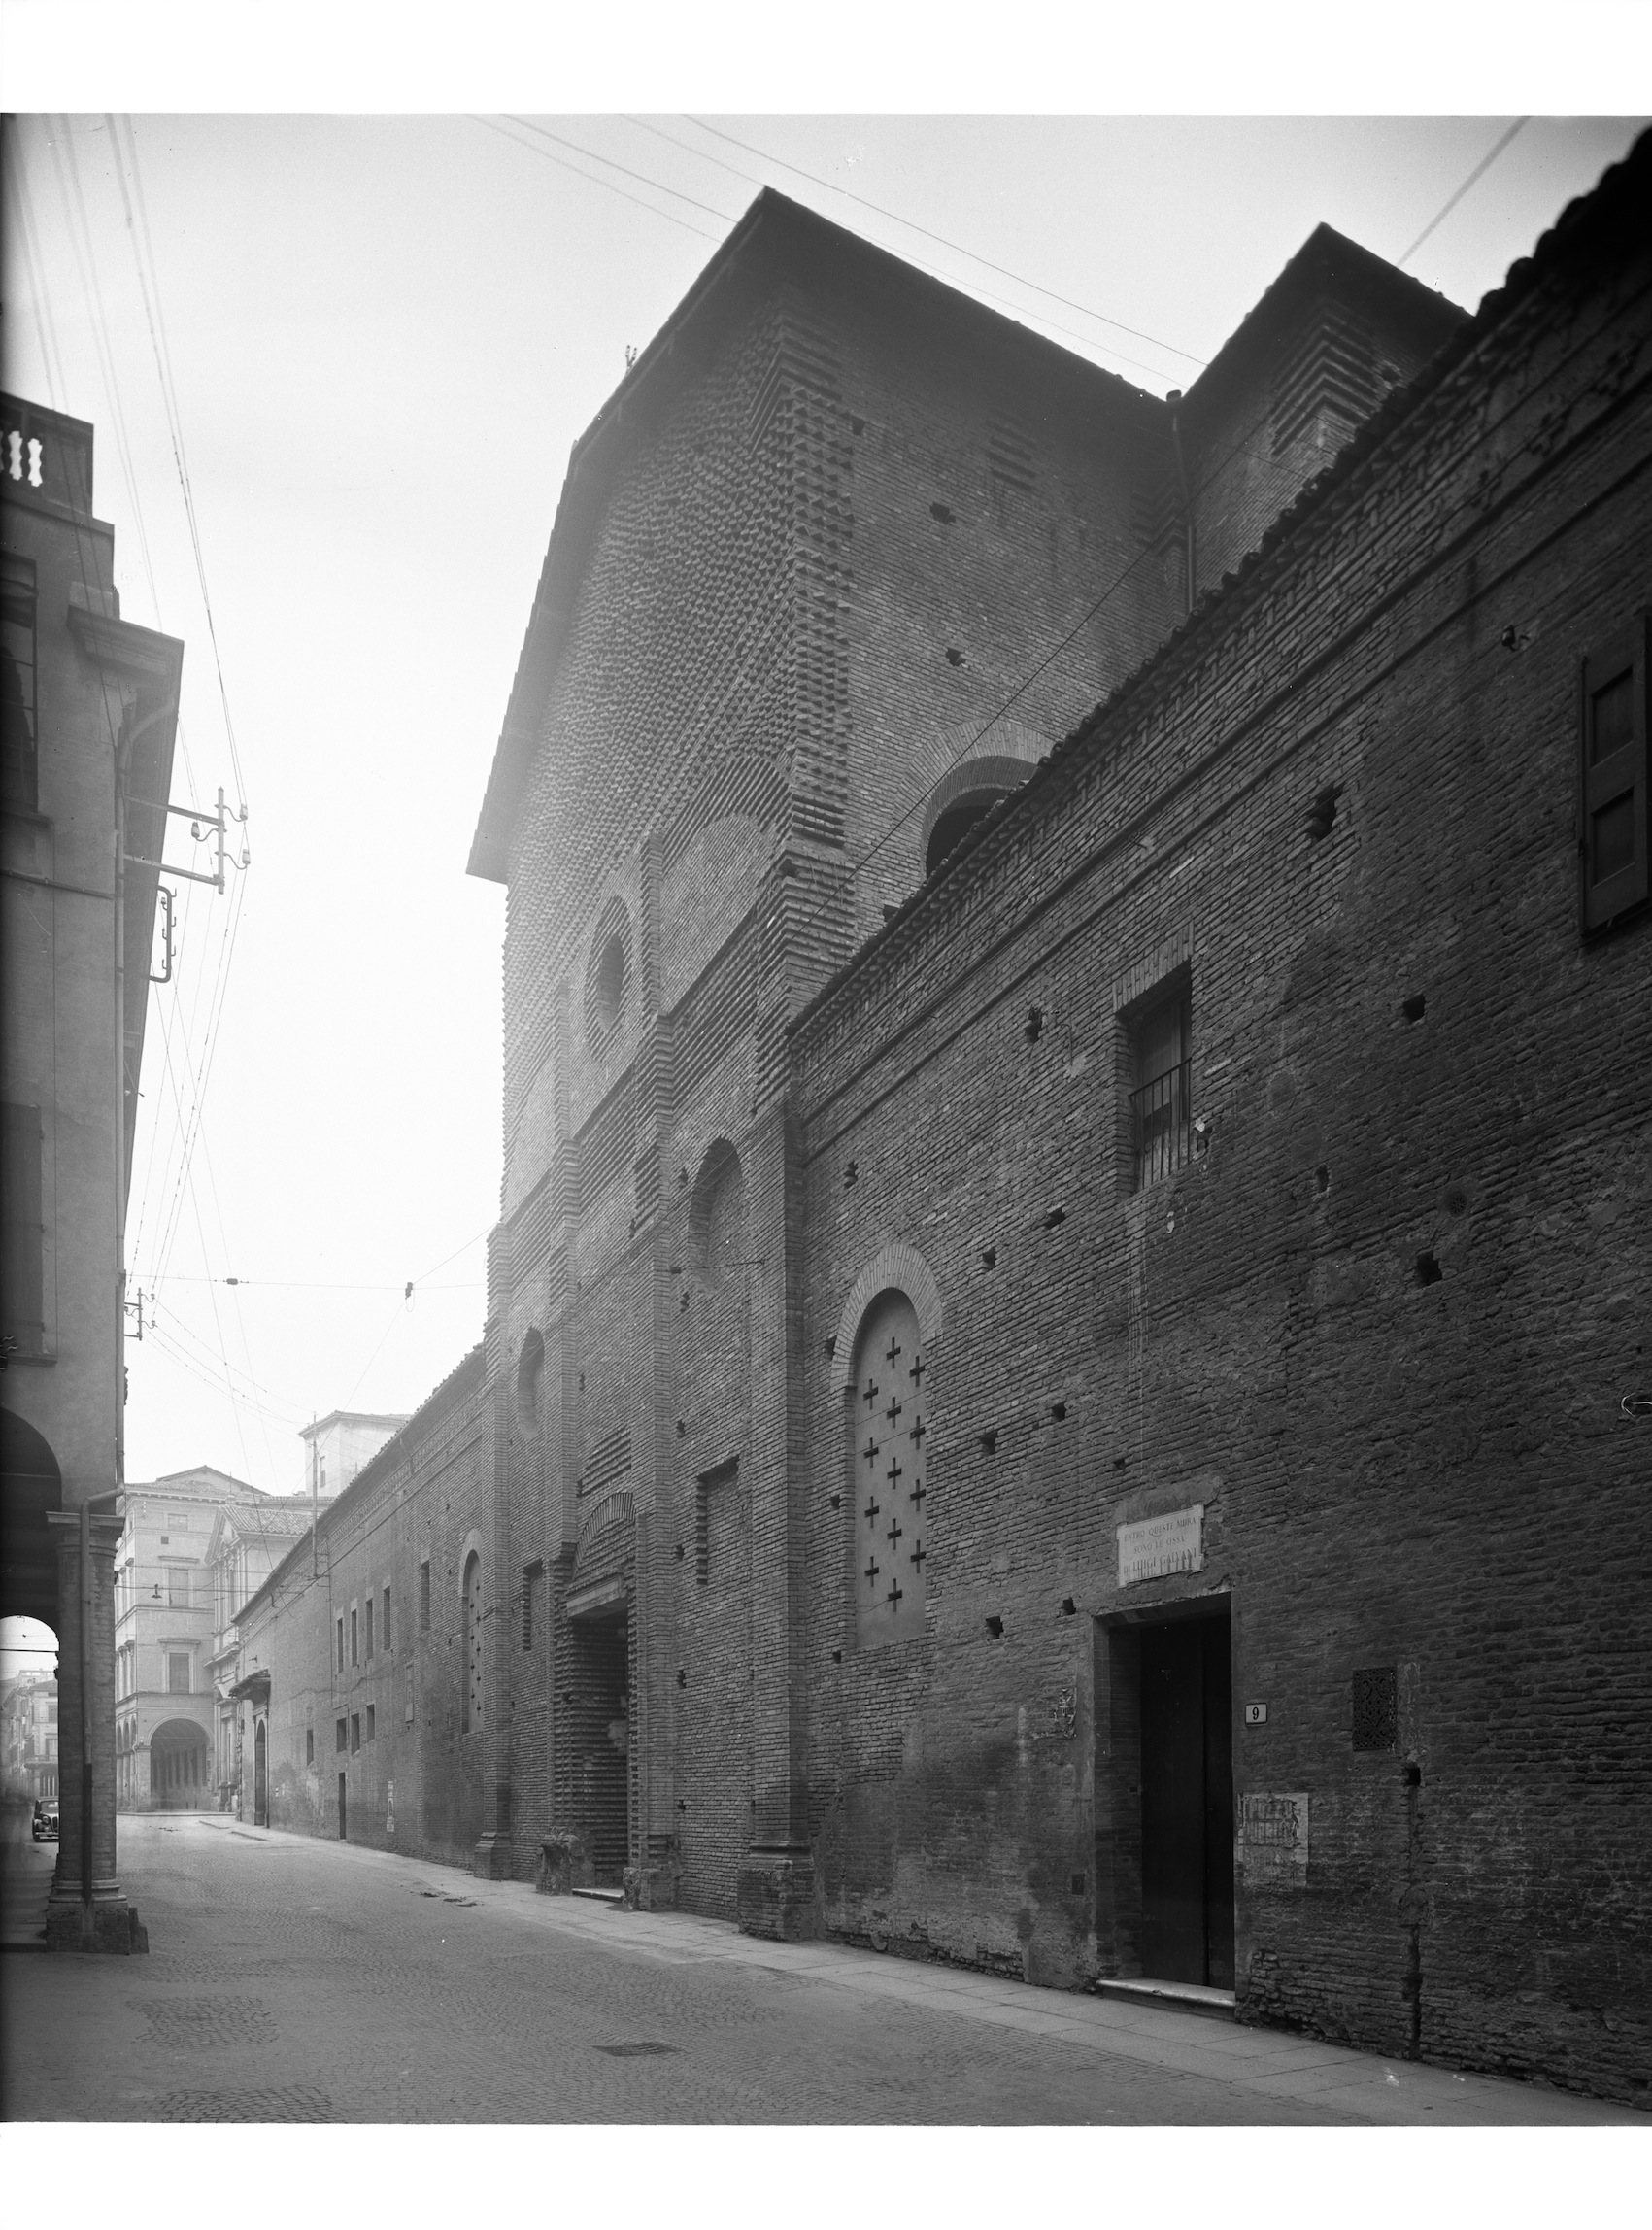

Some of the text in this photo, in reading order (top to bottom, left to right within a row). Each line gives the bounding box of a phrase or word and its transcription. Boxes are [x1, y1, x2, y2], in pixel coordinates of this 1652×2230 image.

[1124, 1517, 1197, 1542] ENTRO QUESTE MURA
[1133, 1535, 1185, 1554] SONO LE OSSA
[1123, 1547, 1197, 1574] DI LUIGI GALVANI
[1252, 1706, 1259, 1720] 9
